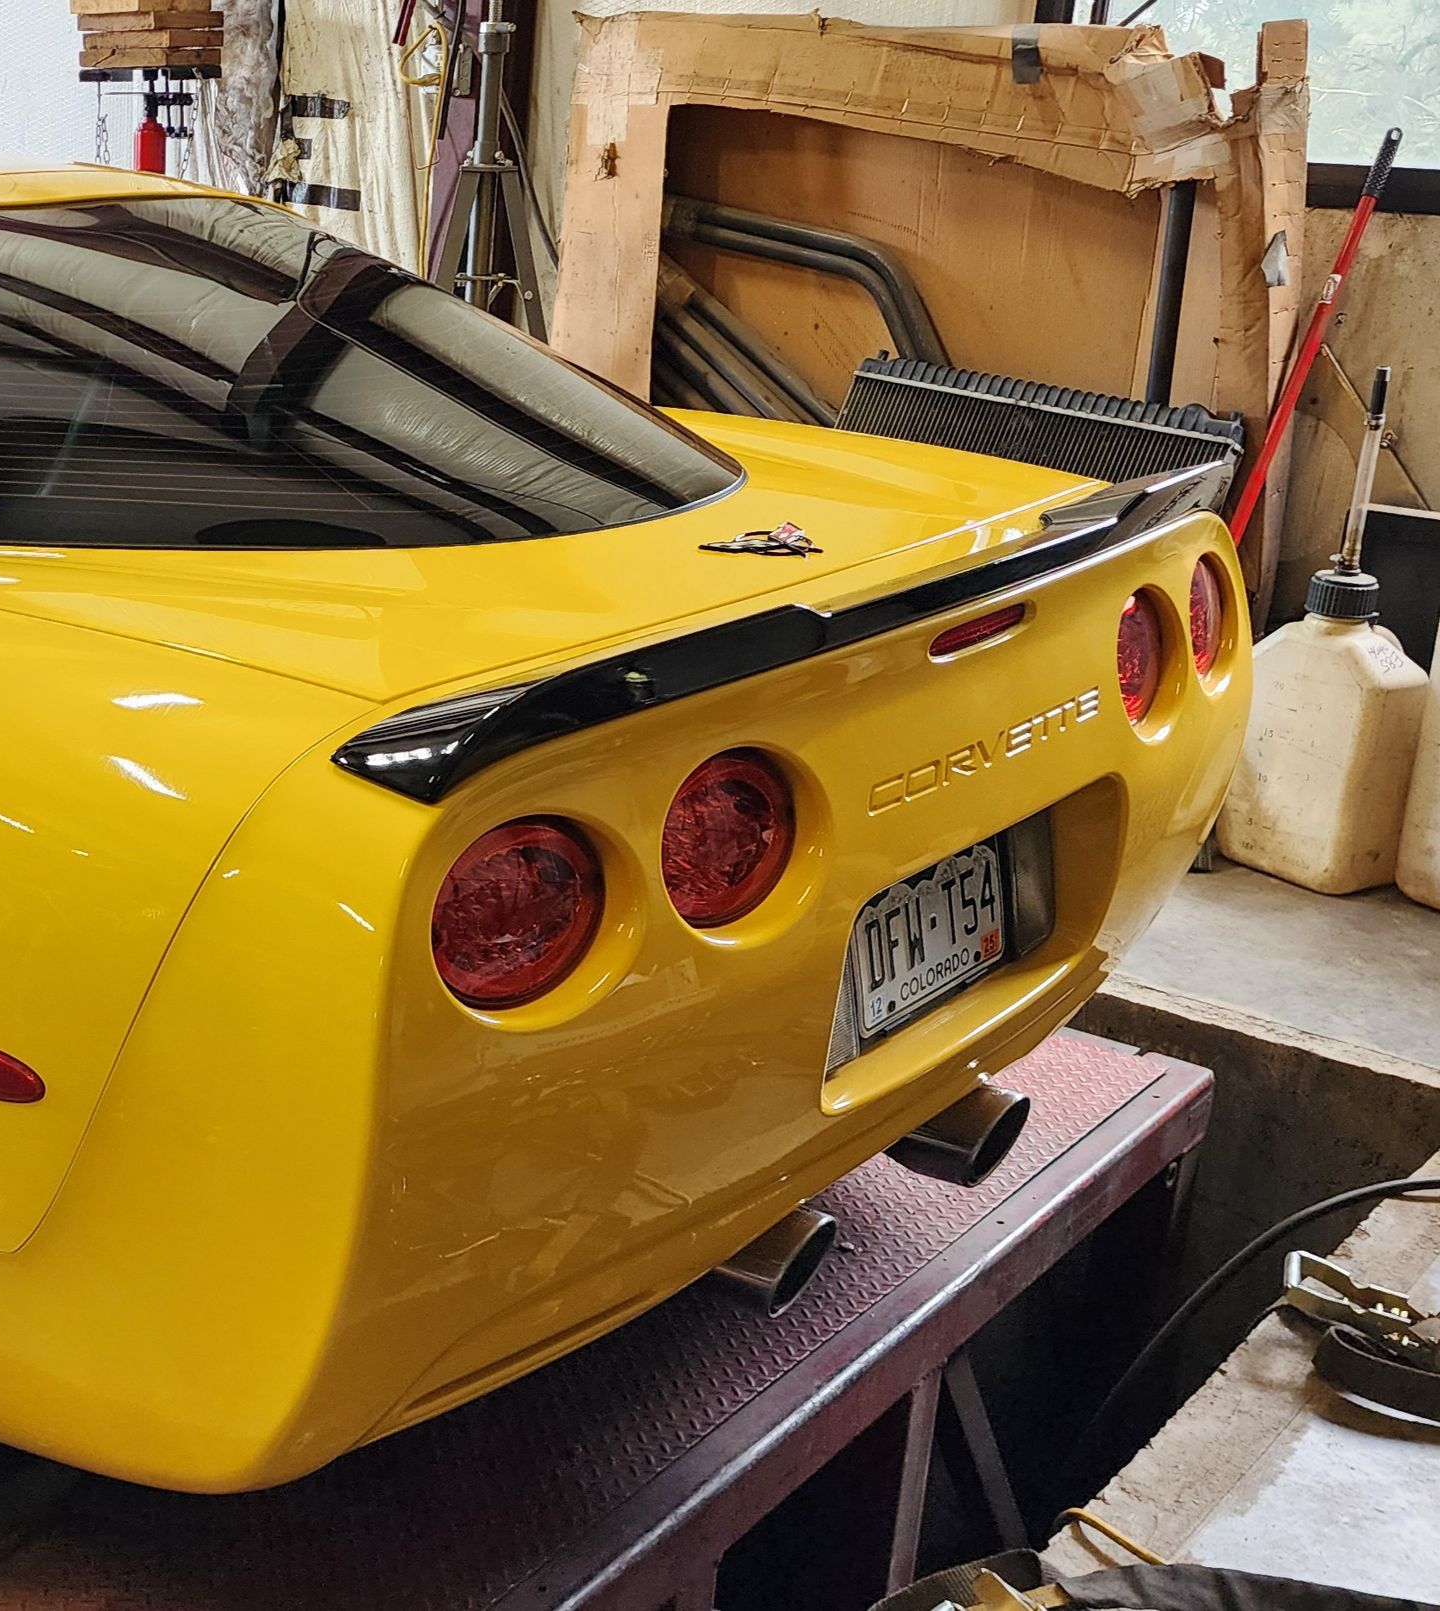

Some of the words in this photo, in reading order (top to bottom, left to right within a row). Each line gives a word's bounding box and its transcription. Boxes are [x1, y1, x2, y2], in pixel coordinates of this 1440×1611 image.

[867, 685, 1100, 816] CORVETTE
[982, 934, 995, 954] 25
[899, 948, 970, 1001] COLORADO
[870, 996, 883, 1017] 12
